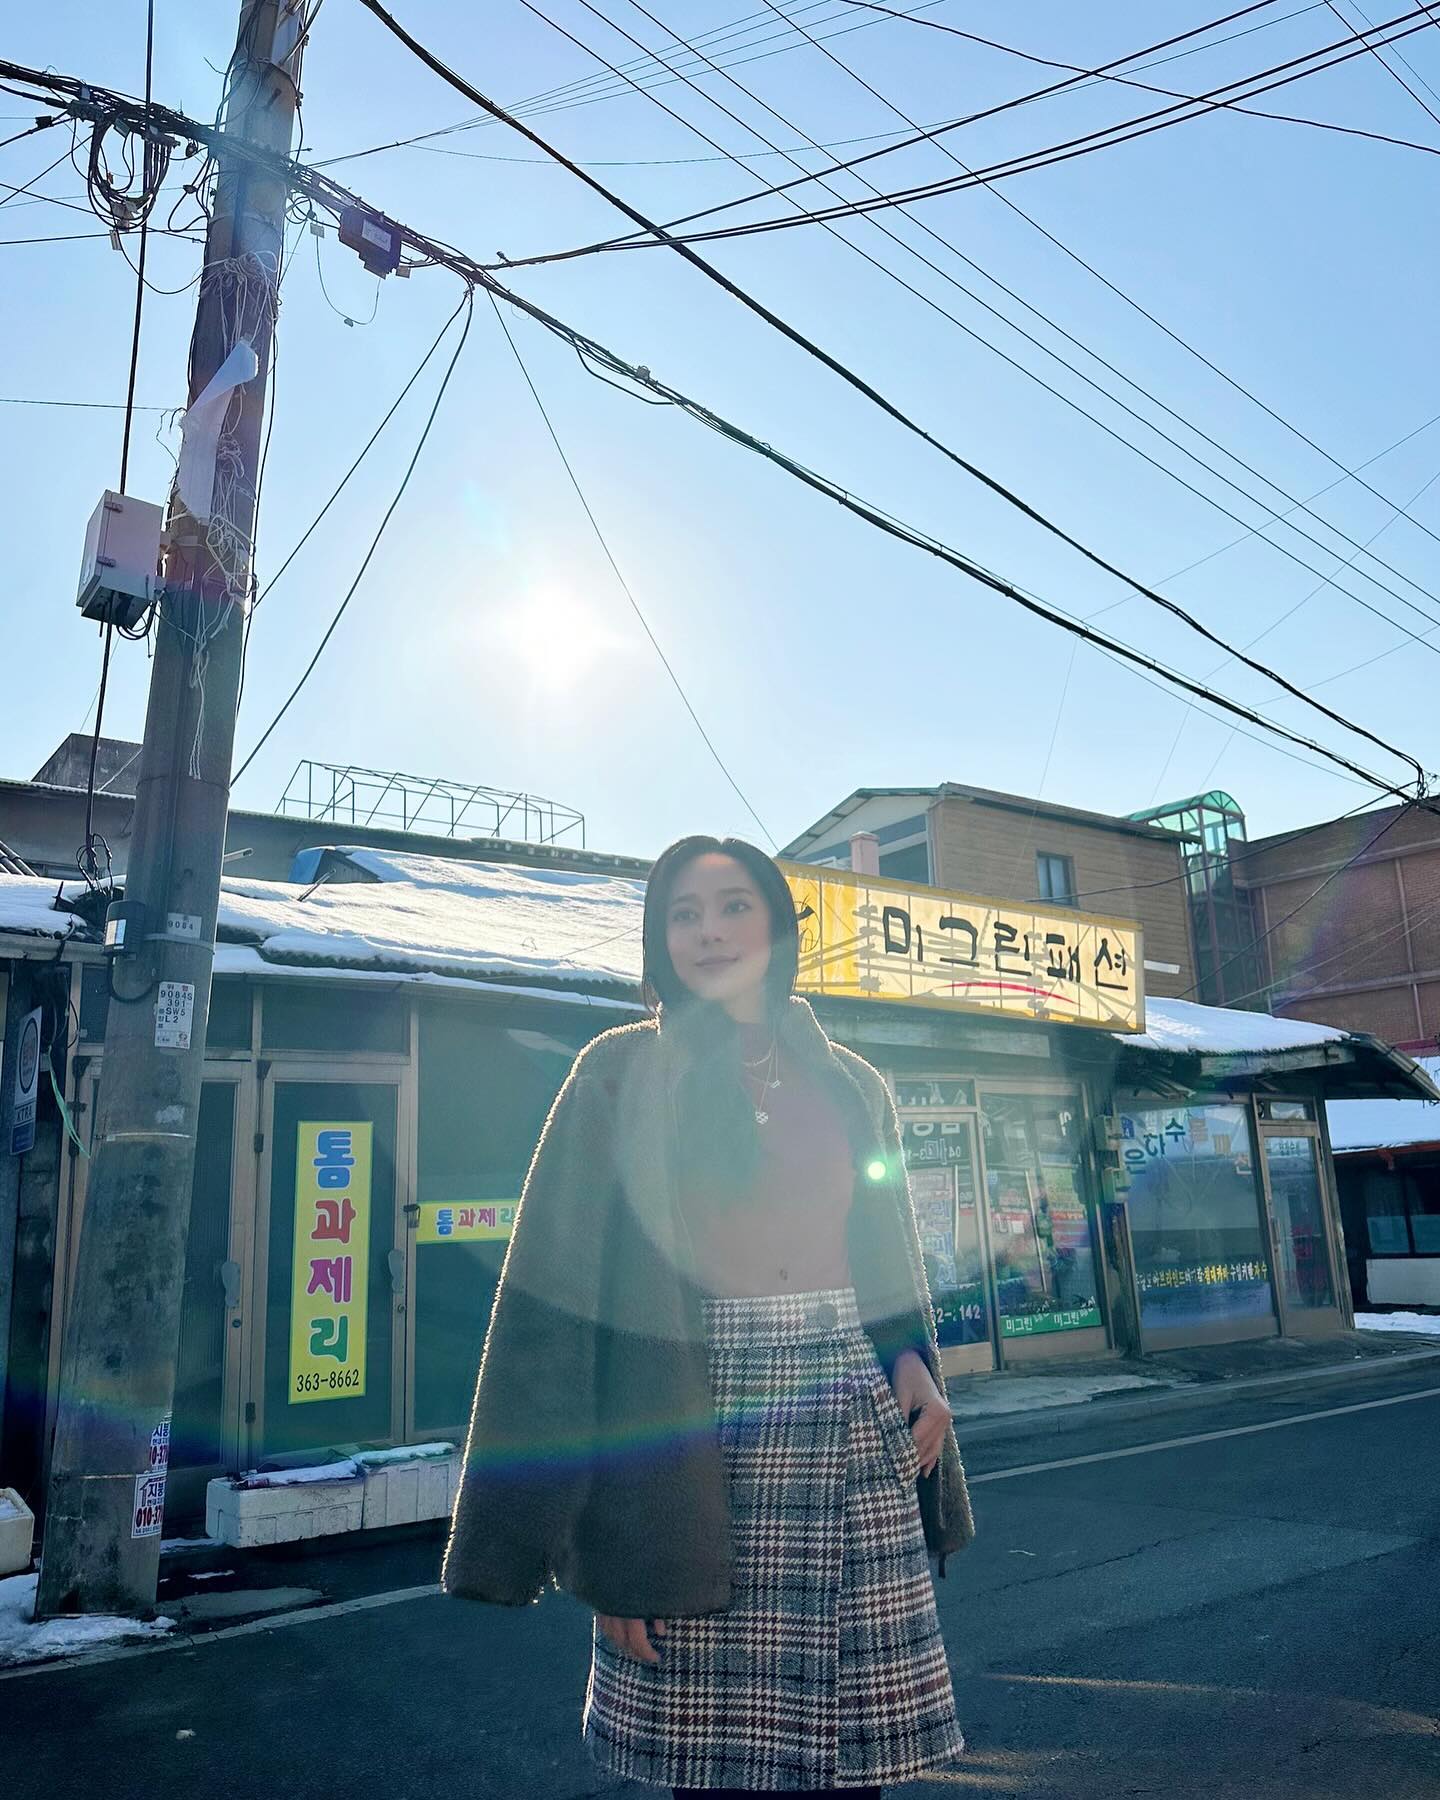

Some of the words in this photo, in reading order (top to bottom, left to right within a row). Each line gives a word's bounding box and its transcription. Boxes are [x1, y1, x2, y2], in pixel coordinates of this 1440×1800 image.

[167, 920, 194, 930] 9084
[883, 905, 1128, 991] 미그린패션
[167, 999, 185, 1008] 391
[296, 1368, 360, 1393] 363-8662
[148, 1482, 164, 1498] 지붕
